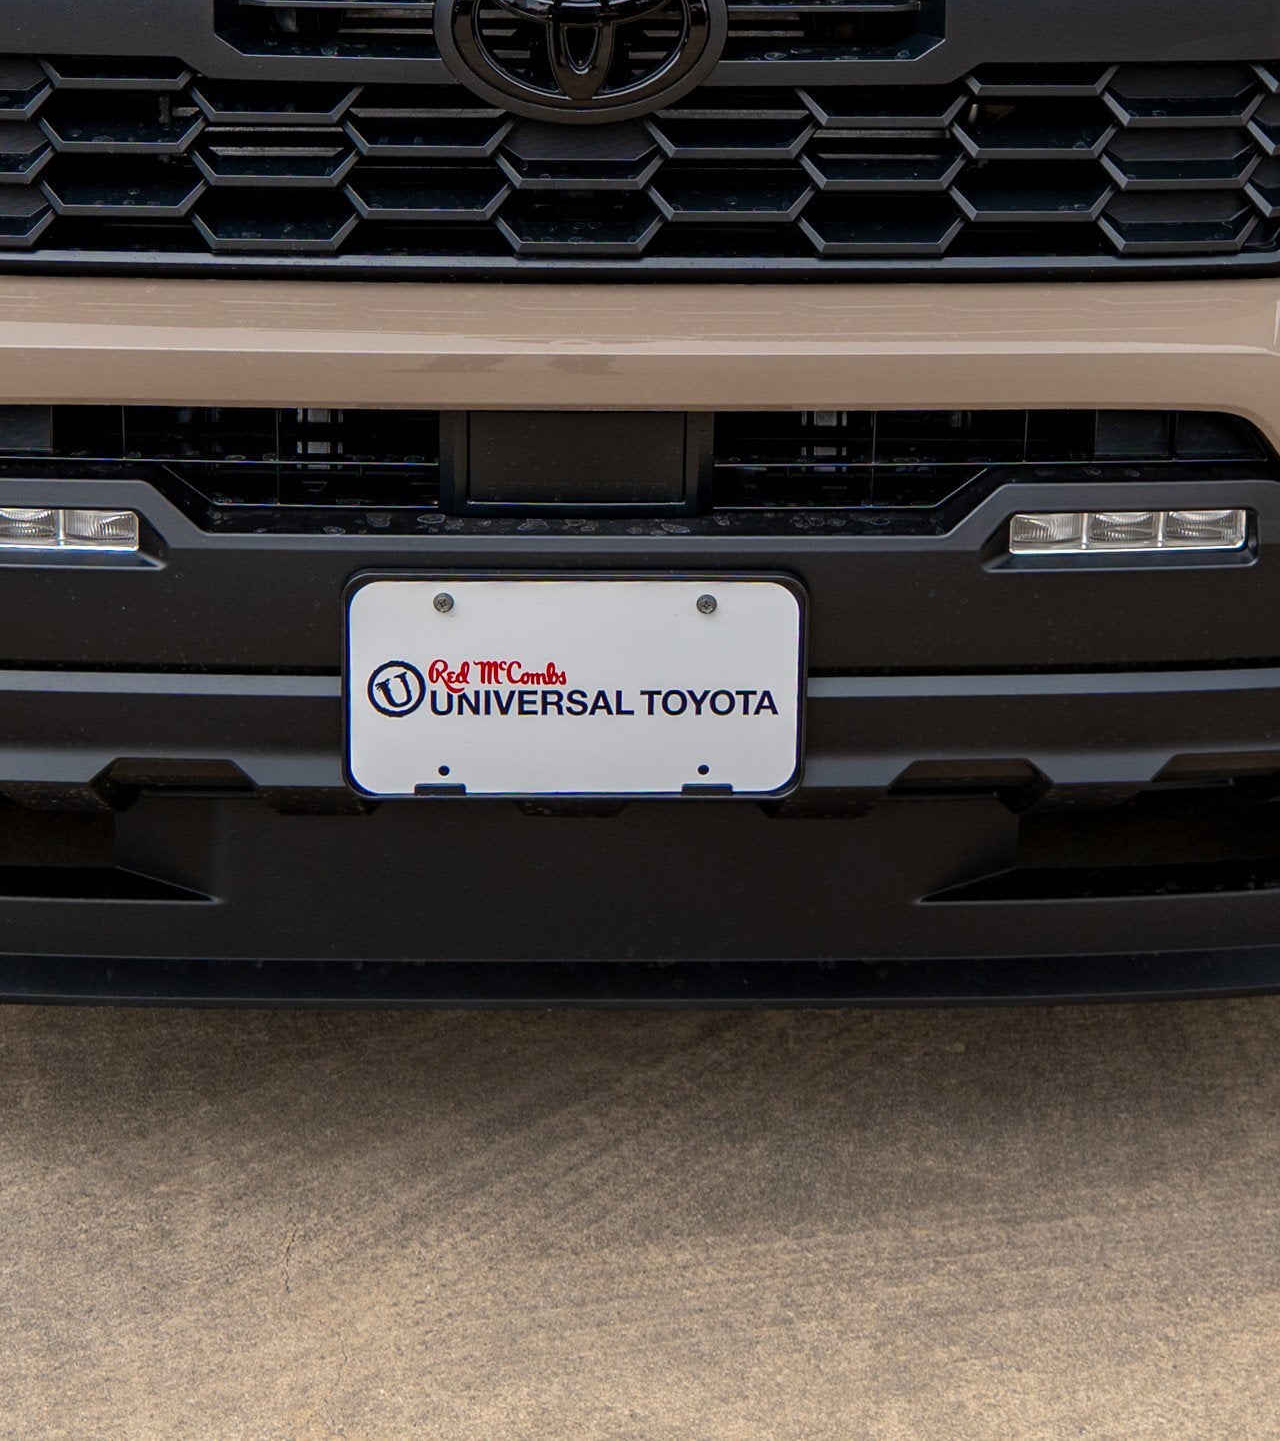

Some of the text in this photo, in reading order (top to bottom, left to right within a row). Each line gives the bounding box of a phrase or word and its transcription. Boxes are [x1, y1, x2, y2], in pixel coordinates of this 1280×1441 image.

[428, 659, 567, 694] Red McCombs
[430, 689, 779, 716] UNIVERSAL TOYOTA
